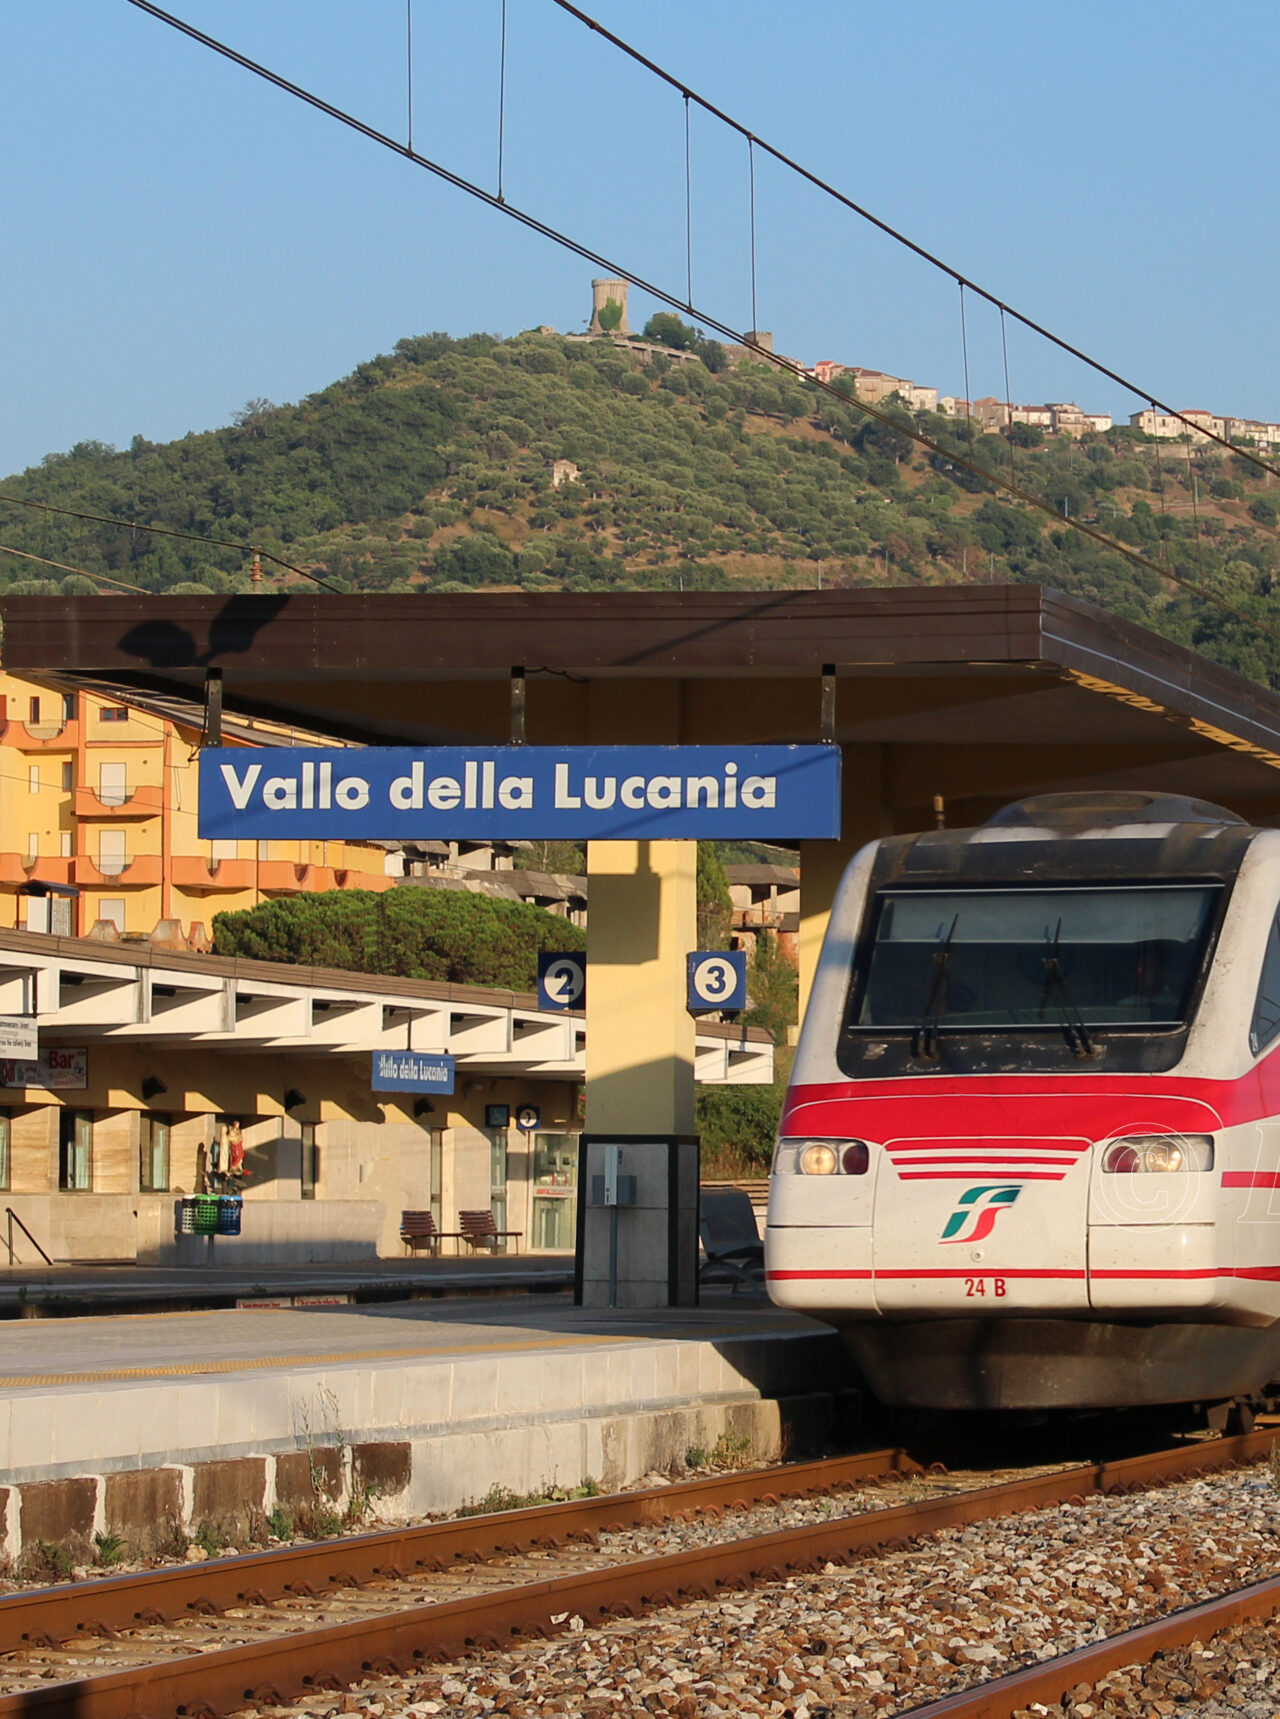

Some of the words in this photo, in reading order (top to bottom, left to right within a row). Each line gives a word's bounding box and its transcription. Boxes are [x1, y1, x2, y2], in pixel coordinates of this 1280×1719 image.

[220, 761, 370, 810] Vallo
[389, 761, 534, 810] della
[555, 761, 777, 810] Lucania
[554, 966, 574, 996] 2
[705, 965, 727, 995] 3
[48, 1051, 75, 1069] Bar
[399, 1057, 418, 1080] della
[419, 1060, 448, 1082] Lucania
[965, 1278, 986, 1297] 24
[994, 1278, 1006, 1297] B
